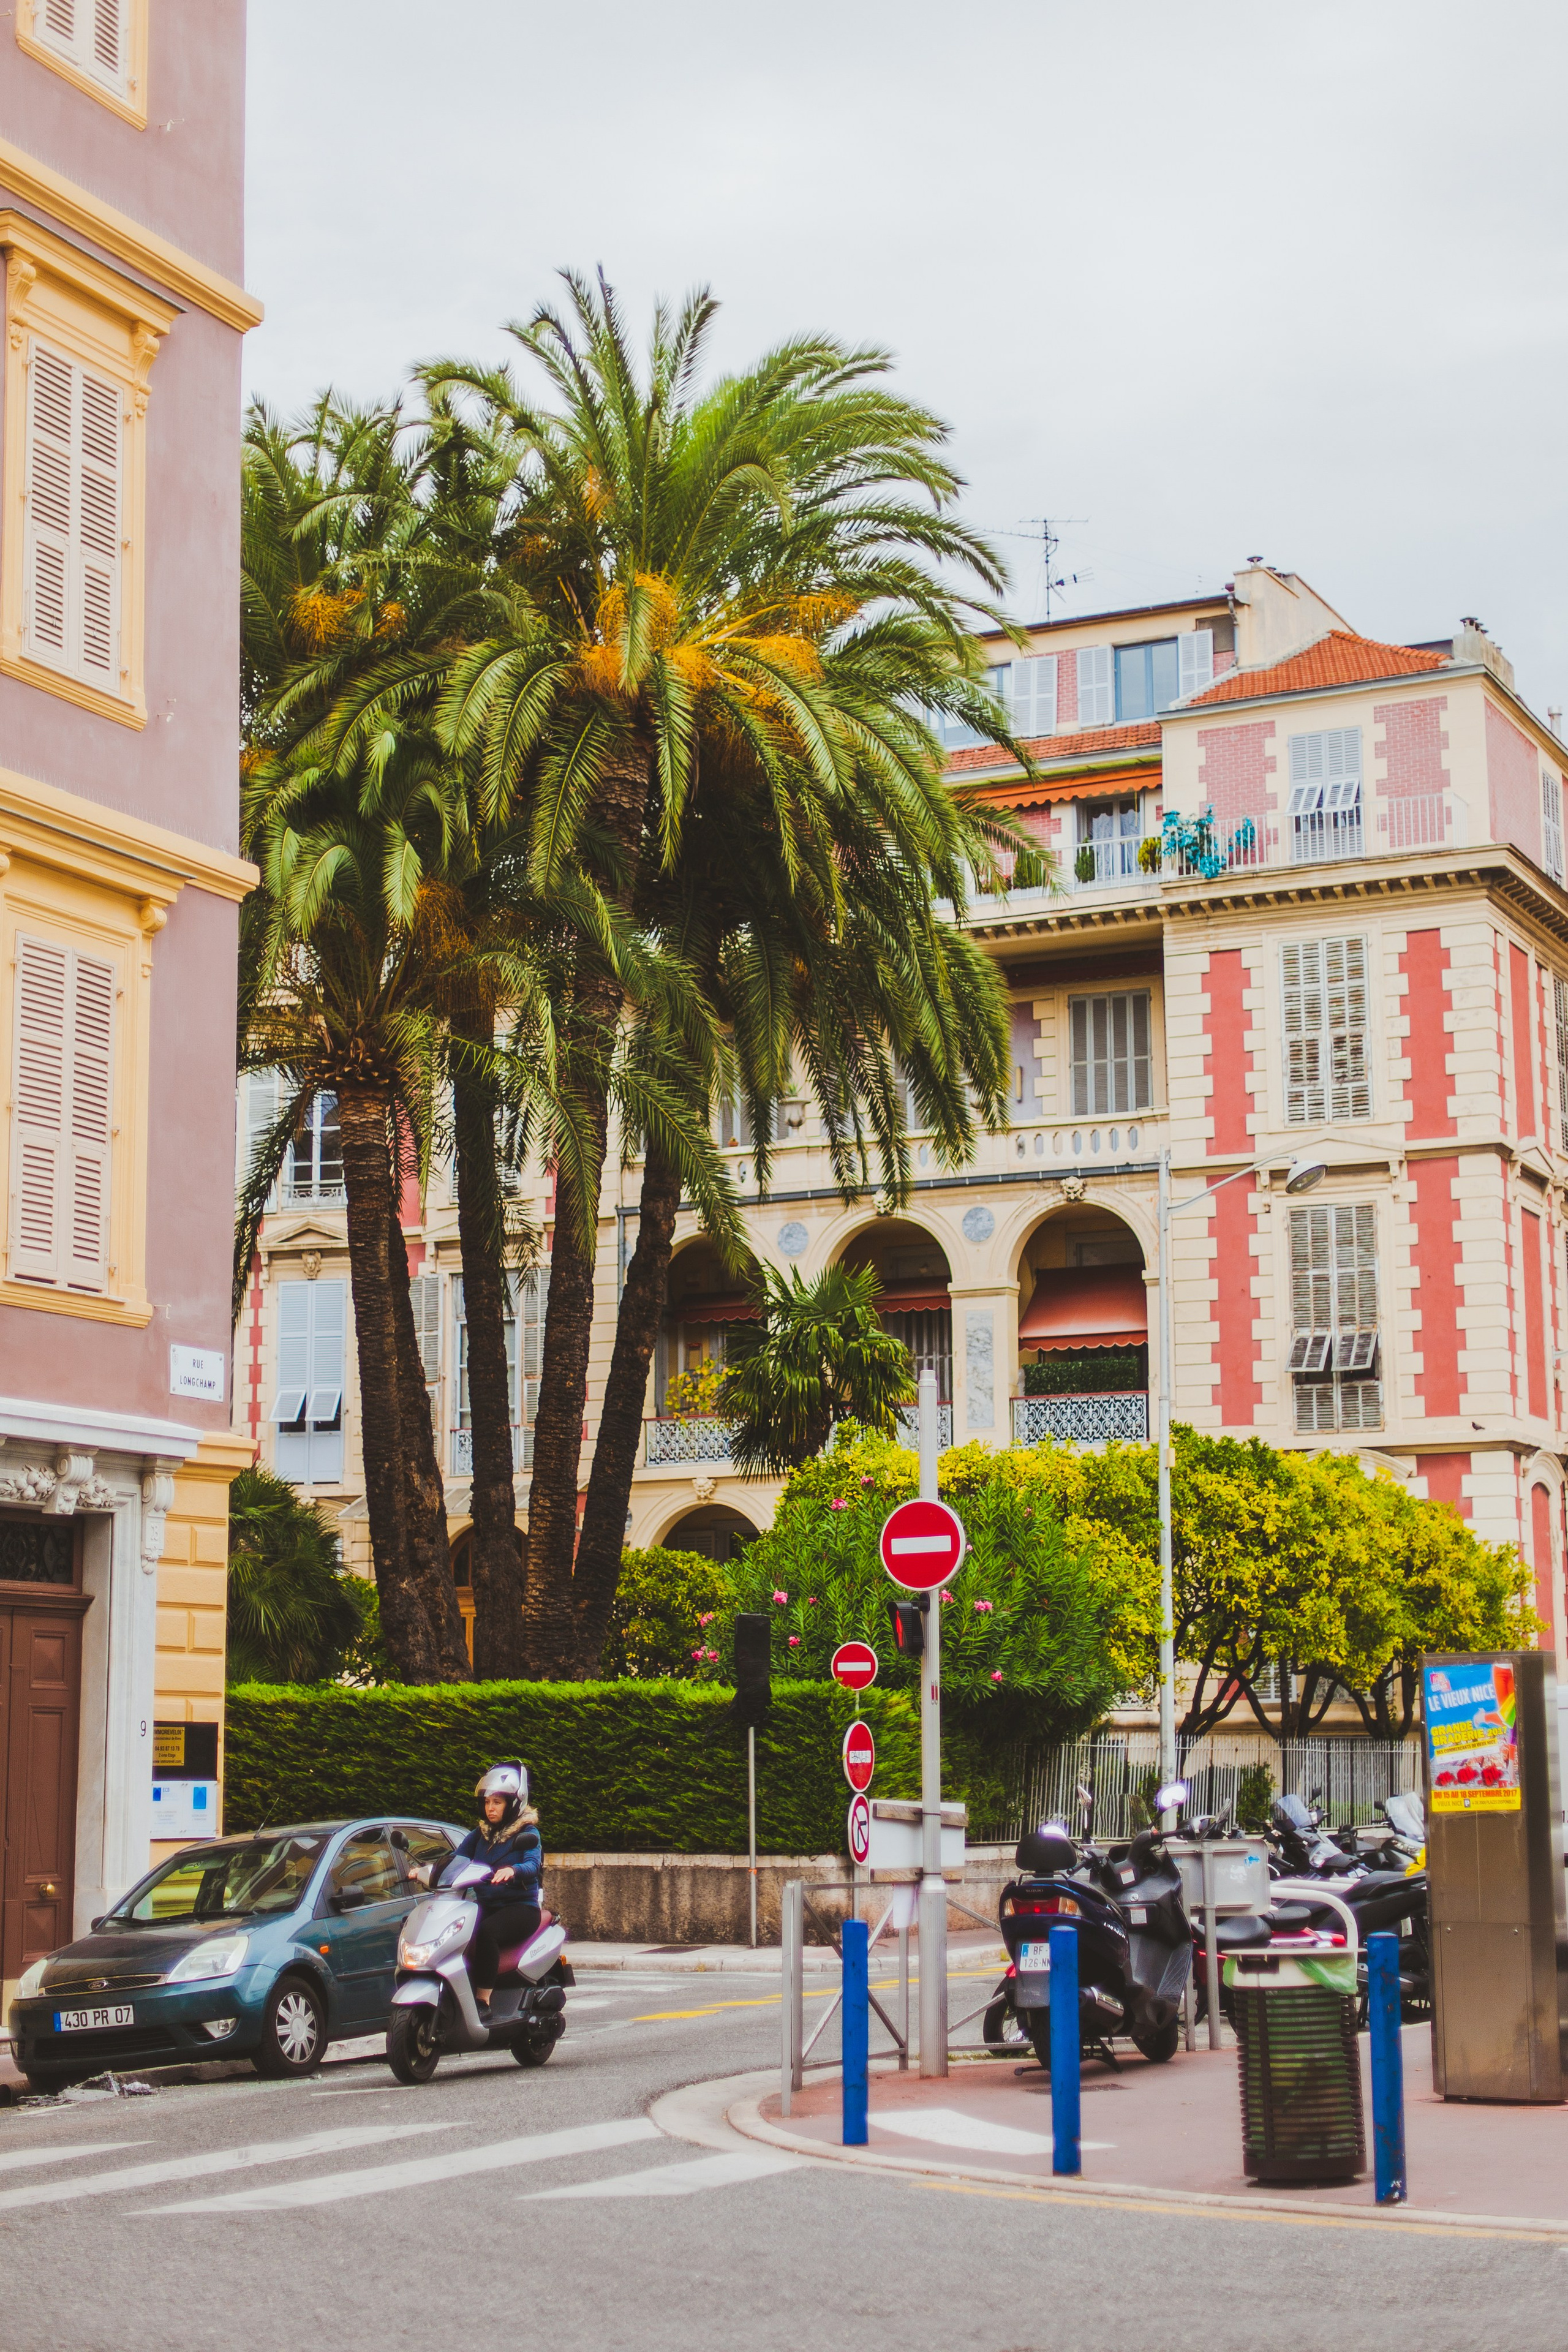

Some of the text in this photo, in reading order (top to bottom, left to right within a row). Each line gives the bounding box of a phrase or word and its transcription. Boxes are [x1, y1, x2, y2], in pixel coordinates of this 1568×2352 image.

[192, 1359, 203, 1369] RUE
[179, 1375, 216, 1390] LONGCHAMP
[1427, 1683, 1496, 1712] LE VIEUX NICE
[140, 1721, 146, 1737] 9
[1430, 1721, 1473, 1737] GRANDE
[1432, 1725, 1507, 1746] BRADERIE 2017
[65, 2011, 88, 2027] 430
[93, 2010, 109, 2026] PR
[115, 2007, 130, 2023] 07
